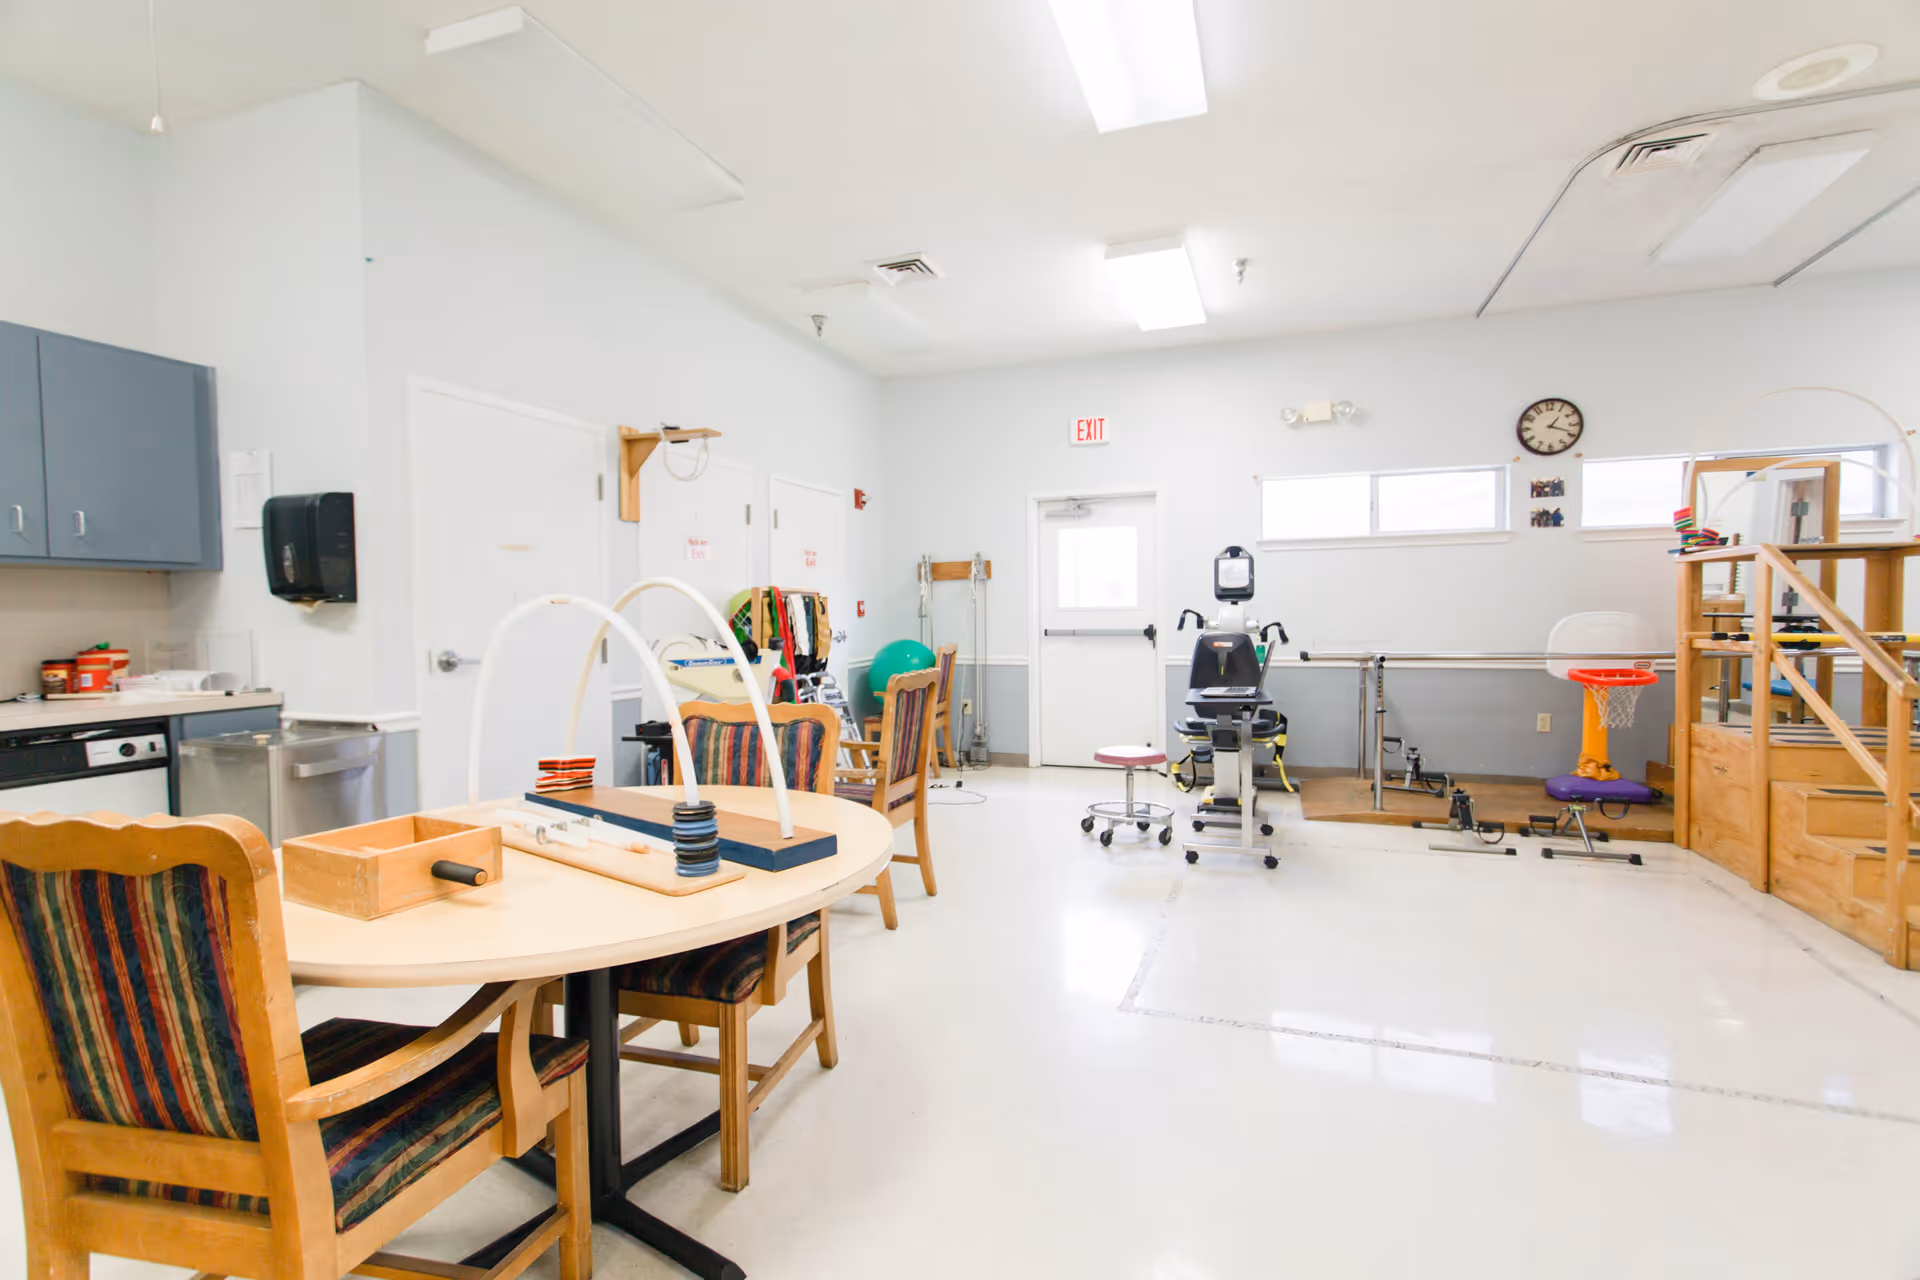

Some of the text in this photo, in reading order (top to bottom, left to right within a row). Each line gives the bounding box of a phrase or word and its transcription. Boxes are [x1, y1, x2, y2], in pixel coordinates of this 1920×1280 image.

[1545, 402, 1555, 411] 12
[1558, 403, 1565, 413] 1
[1564, 410, 1576, 418] 2
[1077, 417, 1105, 441] EXIT
